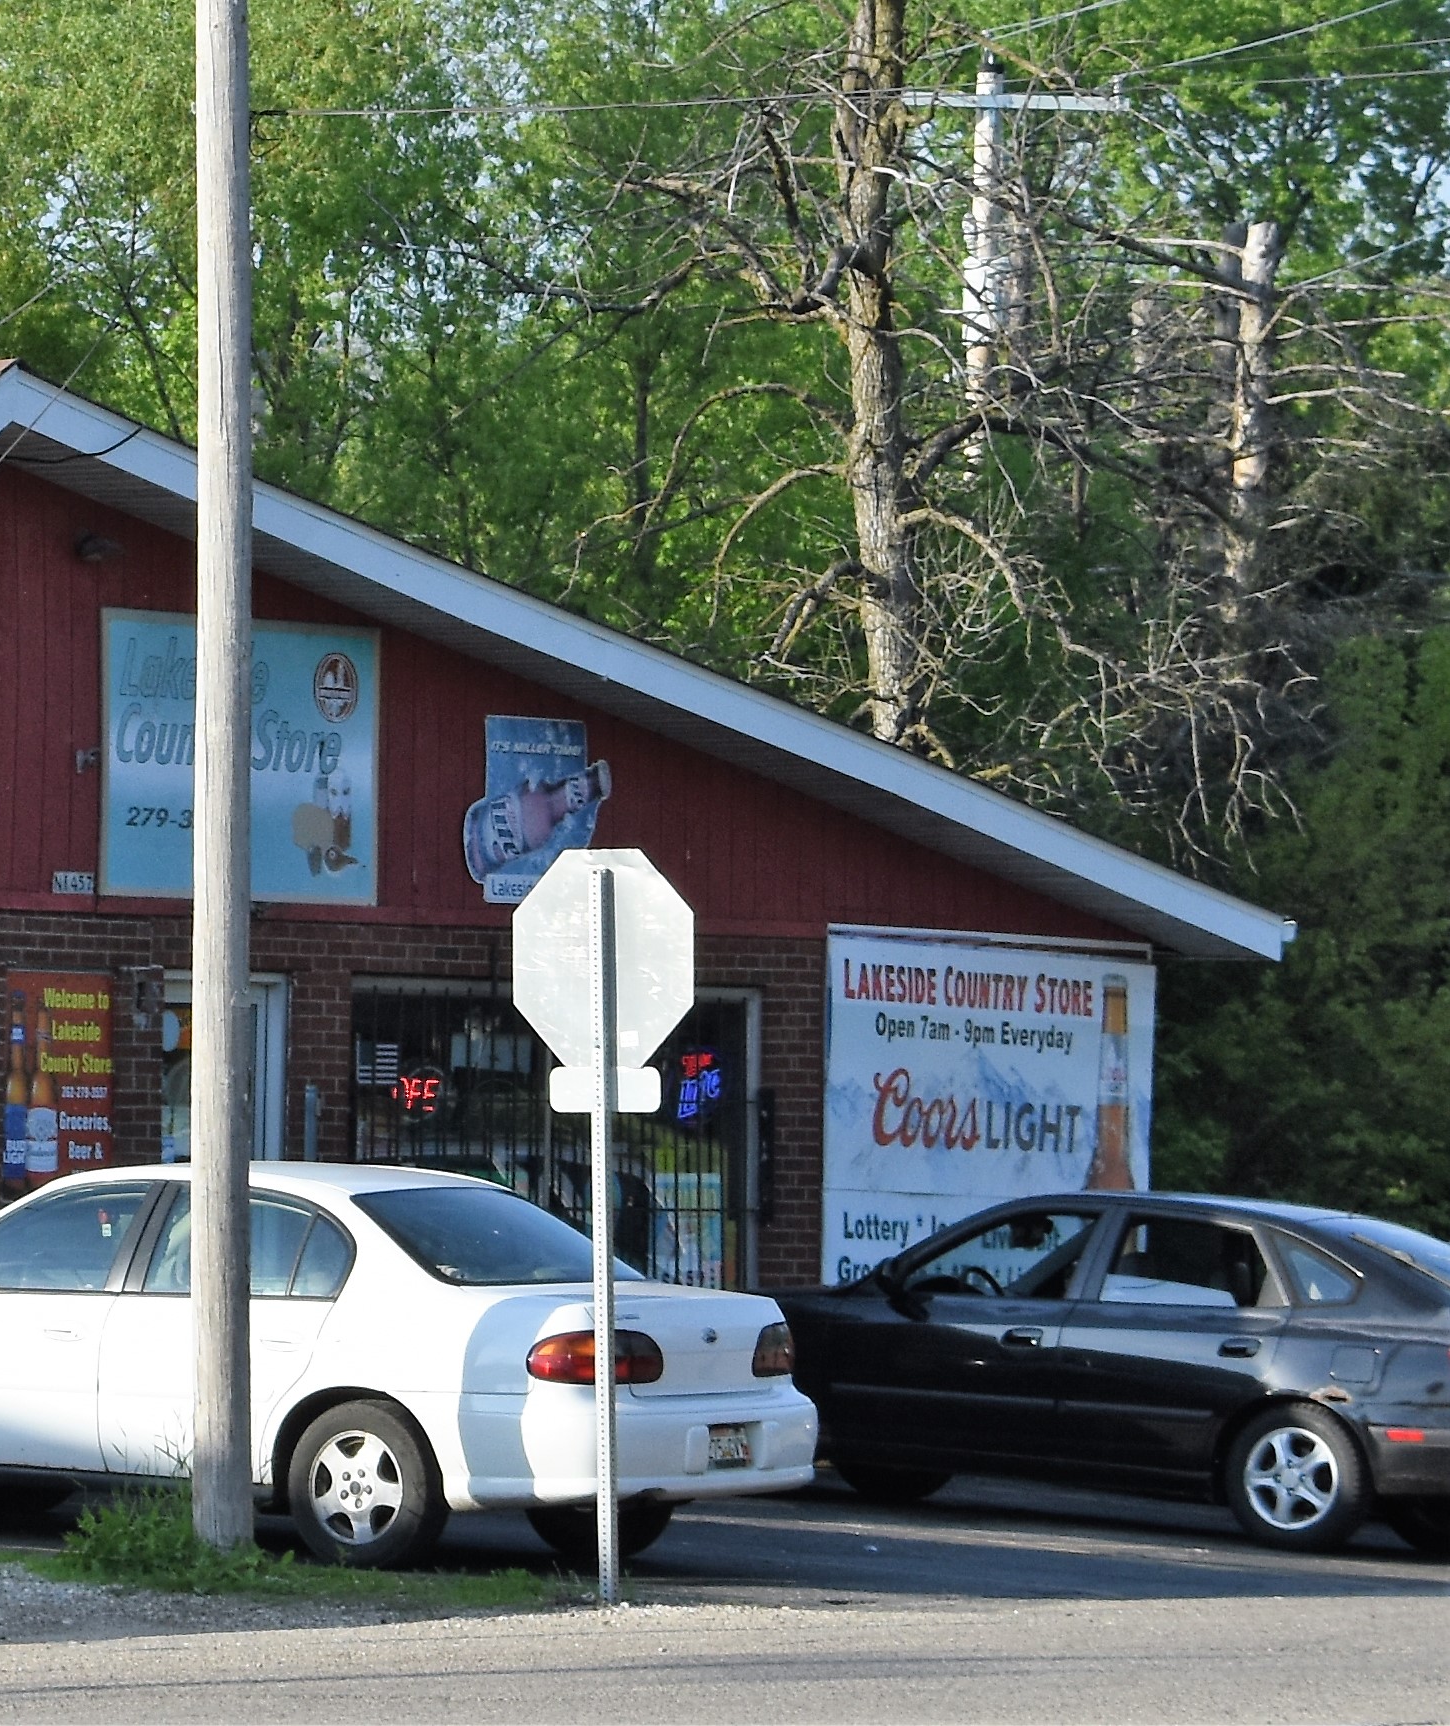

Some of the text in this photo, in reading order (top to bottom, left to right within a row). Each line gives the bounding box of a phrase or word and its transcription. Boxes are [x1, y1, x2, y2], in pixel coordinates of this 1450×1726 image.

[250, 709, 342, 775] Store
[126, 806, 193, 830] 279-3
[44, 987, 109, 1009] Welcome to
[52, 1020, 101, 1042] Lakeside
[875, 1011, 915, 1043] Open
[920, 1015, 950, 1041] 7am
[964, 1018, 995, 1049] 9pm
[1000, 1021, 1073, 1055] Everyday
[873, 1068, 1083, 1154] Coors LIGHT
[68, 1140, 91, 1160] Beer
[94, 1142, 103, 1160] &
[843, 1211, 909, 1248] Lottery
